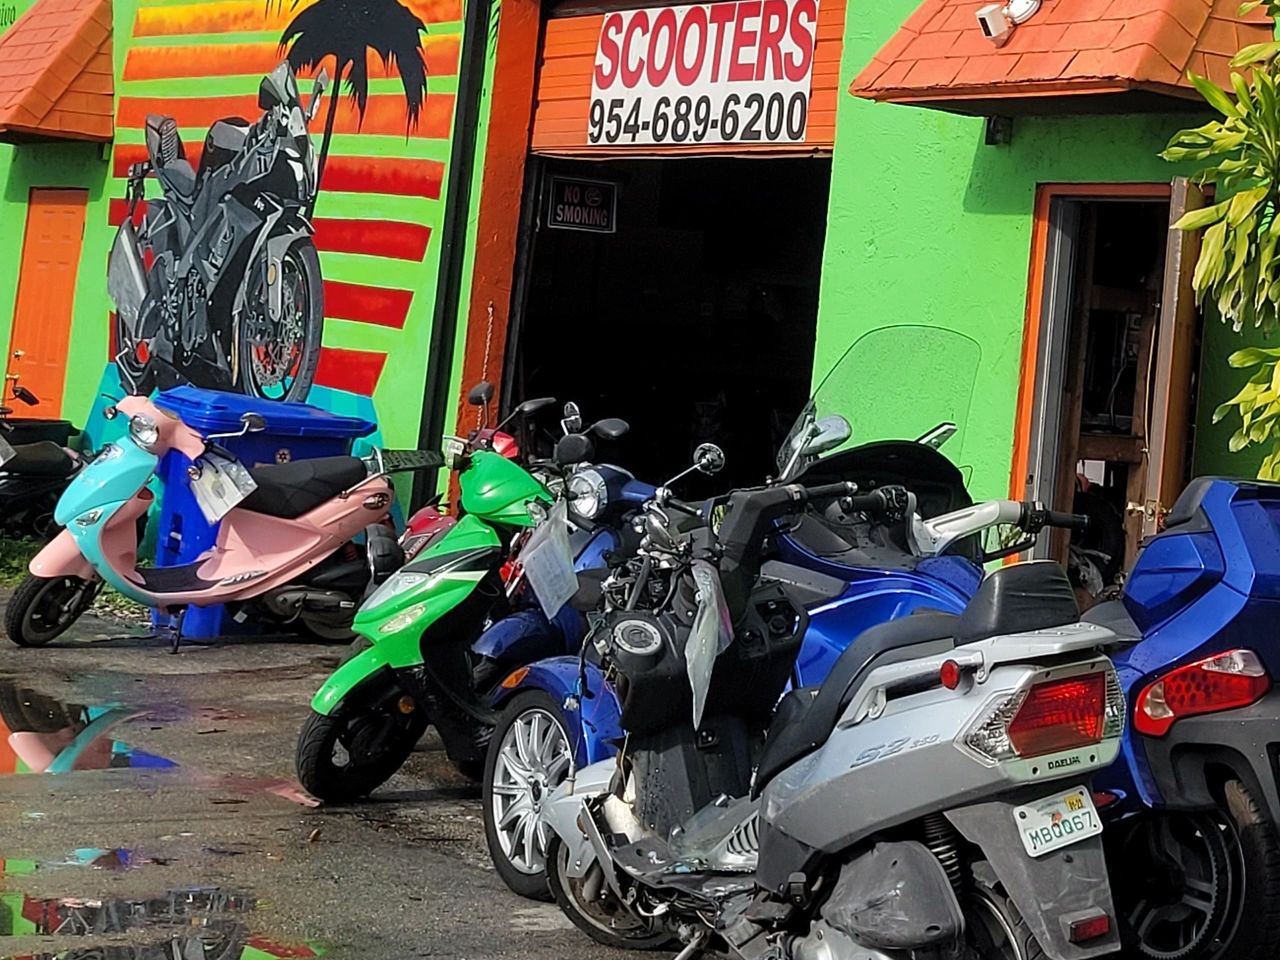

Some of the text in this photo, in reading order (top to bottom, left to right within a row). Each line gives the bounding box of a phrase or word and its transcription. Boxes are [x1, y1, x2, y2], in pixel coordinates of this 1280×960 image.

[588, 91, 807, 144] 954-689-6200
[564, 185, 580, 204] NO
[556, 203, 608, 226] SMOKING
